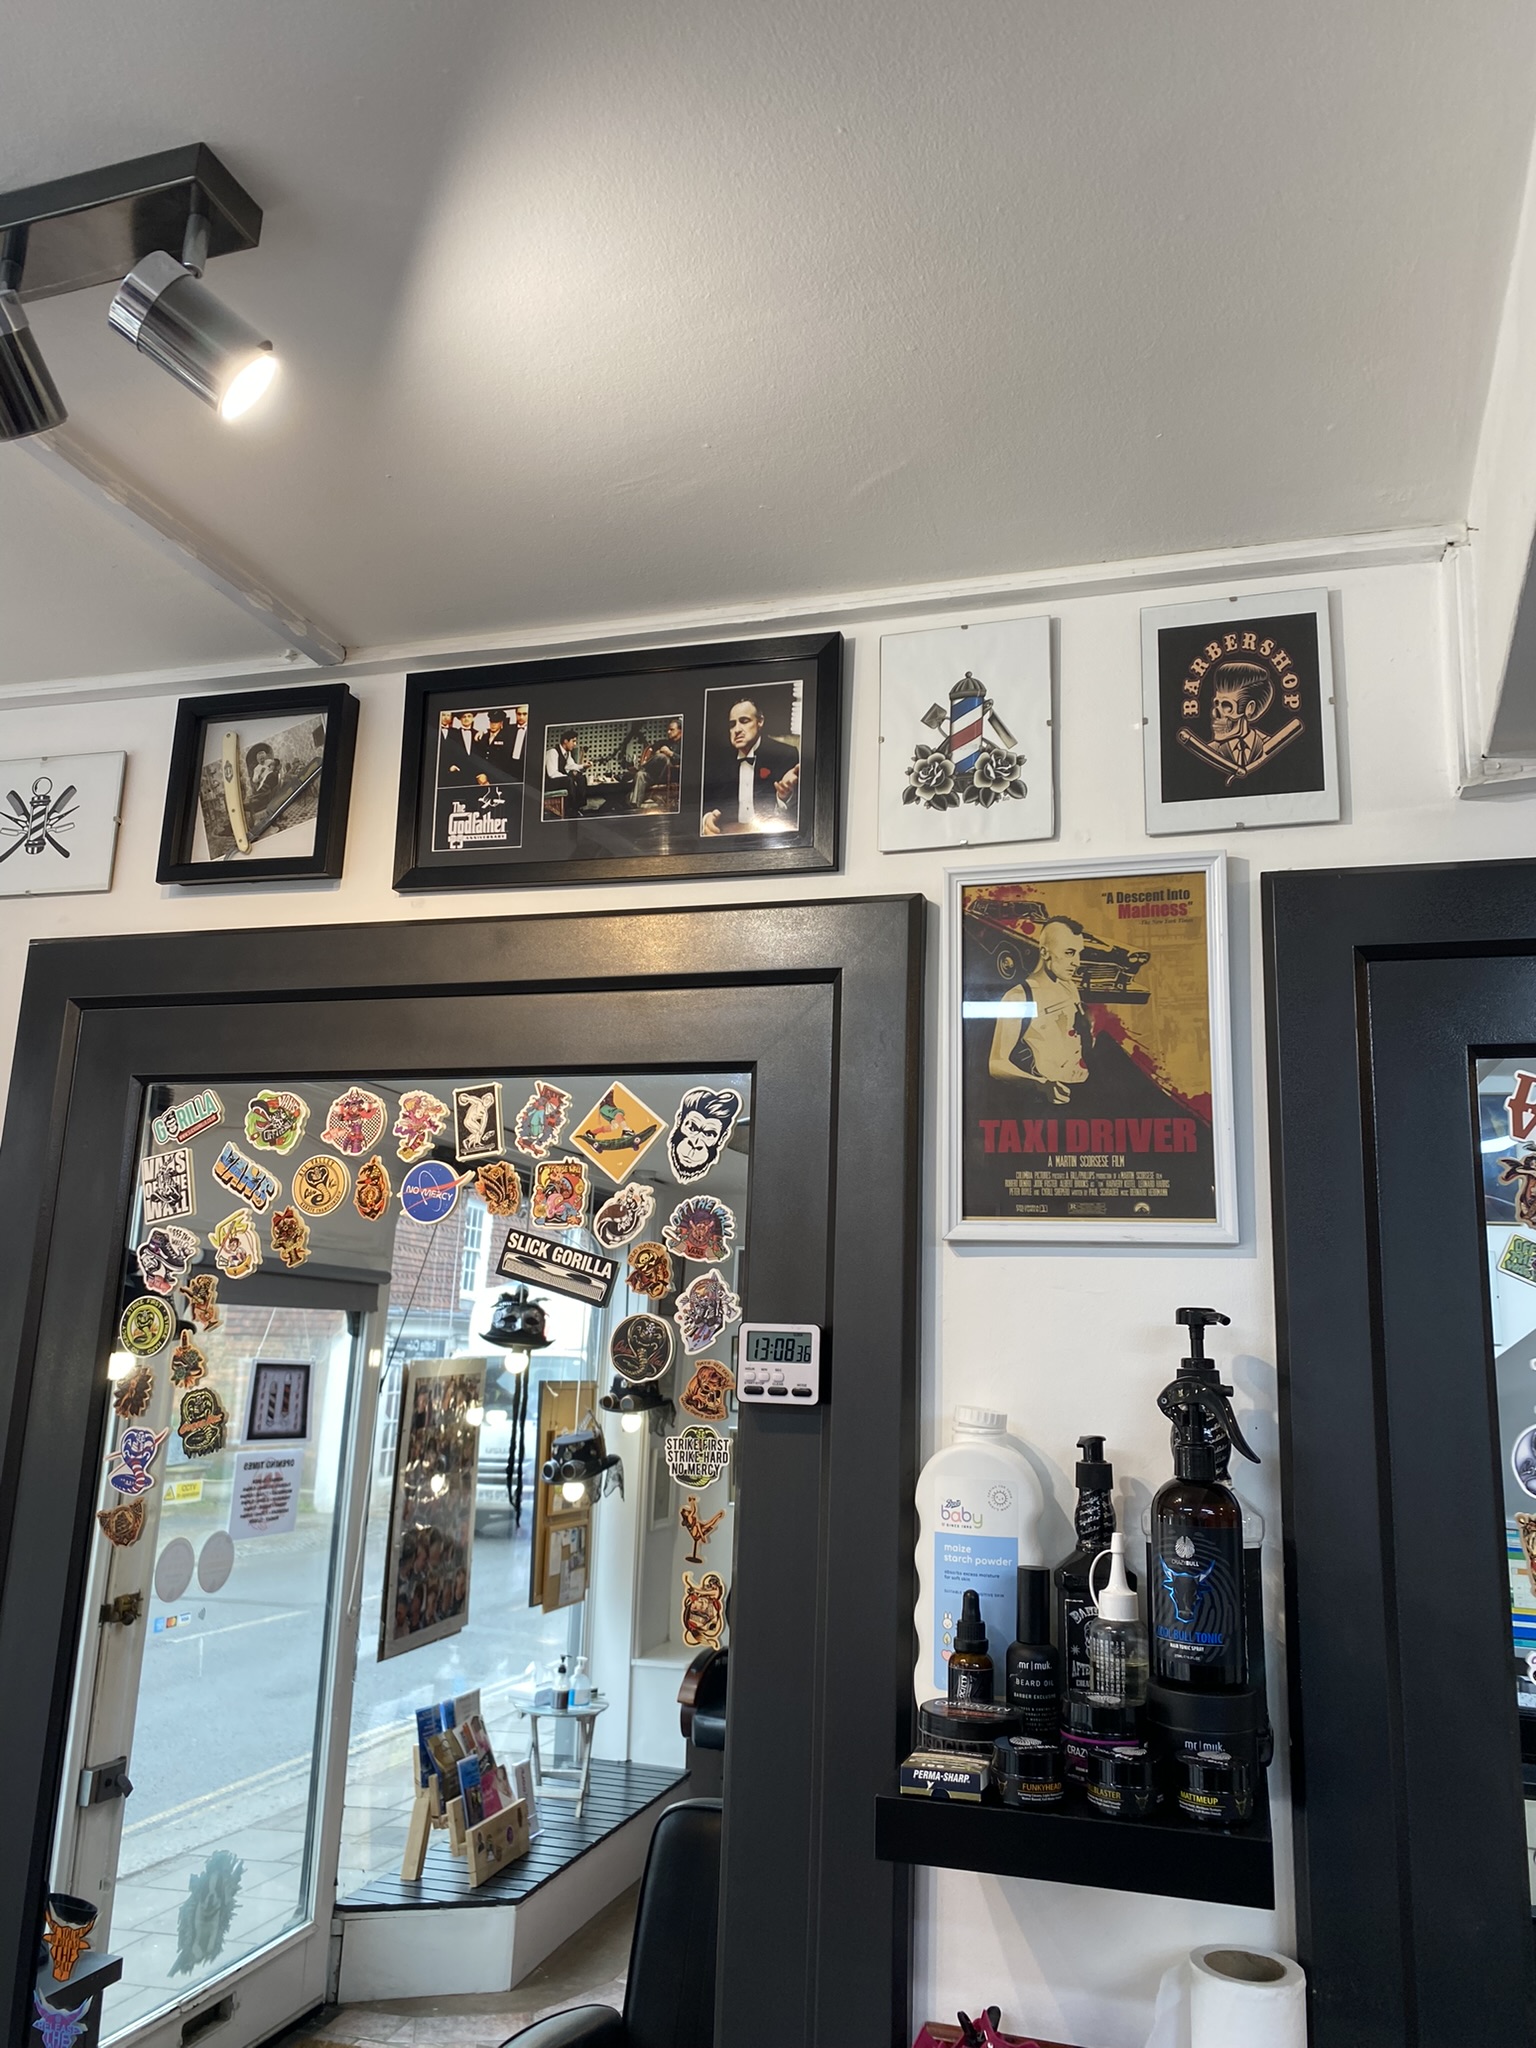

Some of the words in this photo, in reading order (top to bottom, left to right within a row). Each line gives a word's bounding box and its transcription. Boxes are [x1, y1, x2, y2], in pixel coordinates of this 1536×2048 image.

[1183, 633, 1300, 715] BARBERSHOP
[452, 801, 466, 813] The
[448, 811, 508, 835] Godfather
[1116, 890, 1165, 904] Descent
[1167, 888, 1190, 901] Into
[979, 1119, 1058, 1153] TAXI
[1066, 1118, 1198, 1152] DRIVER
[1048, 1155, 1053, 1168] A
[1055, 1155, 1077, 1168] MARTIN
[1079, 1155, 1109, 1168] SCORSESE
[1112, 1155, 1125, 1167] FILM
[214, 1144, 275, 1210] VANS
[406, 1185, 419, 1195] NO
[421, 1188, 454, 1201] MERCY
[672, 1202, 689, 1226] OFF
[692, 1198, 716, 1210] THE
[714, 1207, 733, 1237] WALL
[507, 1232, 551, 1260] SLICK
[552, 1247, 613, 1279] GORILLA
[754, 1337, 795, 1361] 13:08
[797, 1345, 811, 1362] 36
[667, 1438, 698, 1450] STRIKE
[703, 1439, 729, 1451] FIRST
[668, 1451, 699, 1462] STRIKE
[704, 1452, 728, 1463] HARD
[672, 1463, 684, 1474] NO
[688, 1463, 720, 1476] MERCY
[941, 1504, 983, 1529] baby
[944, 1544, 972, 1553] maize
[944, 1554, 973, 1564] starch
[975, 1557, 1013, 1566] powder
[1173, 1629, 1192, 1642] BULL
[1195, 1631, 1223, 1644] TONIC
[1072, 1660, 1090, 1677] AFTE
[1016, 1678, 1041, 1687] BEARD
[1022, 1782, 1062, 1791] FUNKYHEAD
[1180, 1790, 1218, 1805] MATTMEUP
